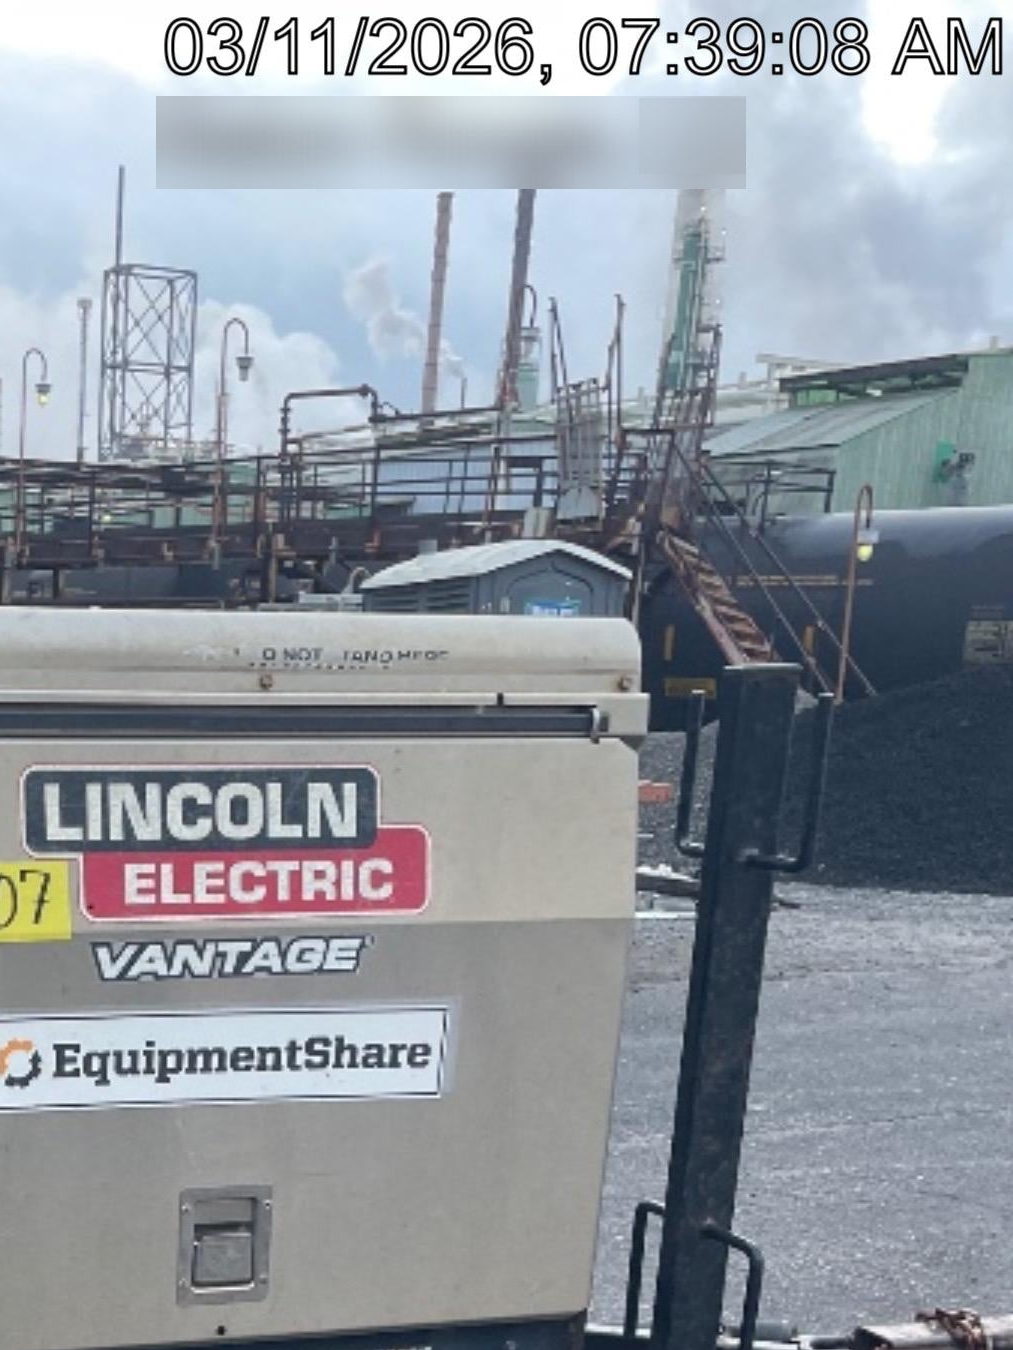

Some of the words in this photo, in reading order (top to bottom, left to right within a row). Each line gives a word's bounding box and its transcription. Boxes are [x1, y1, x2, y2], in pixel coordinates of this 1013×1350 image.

[43, 782, 358, 841] LINCOLN
[124, 860, 393, 905] ELECTRIC
[91, 936, 364, 981] VANTAGE
[52, 1036, 432, 1086] EquipmentShare
